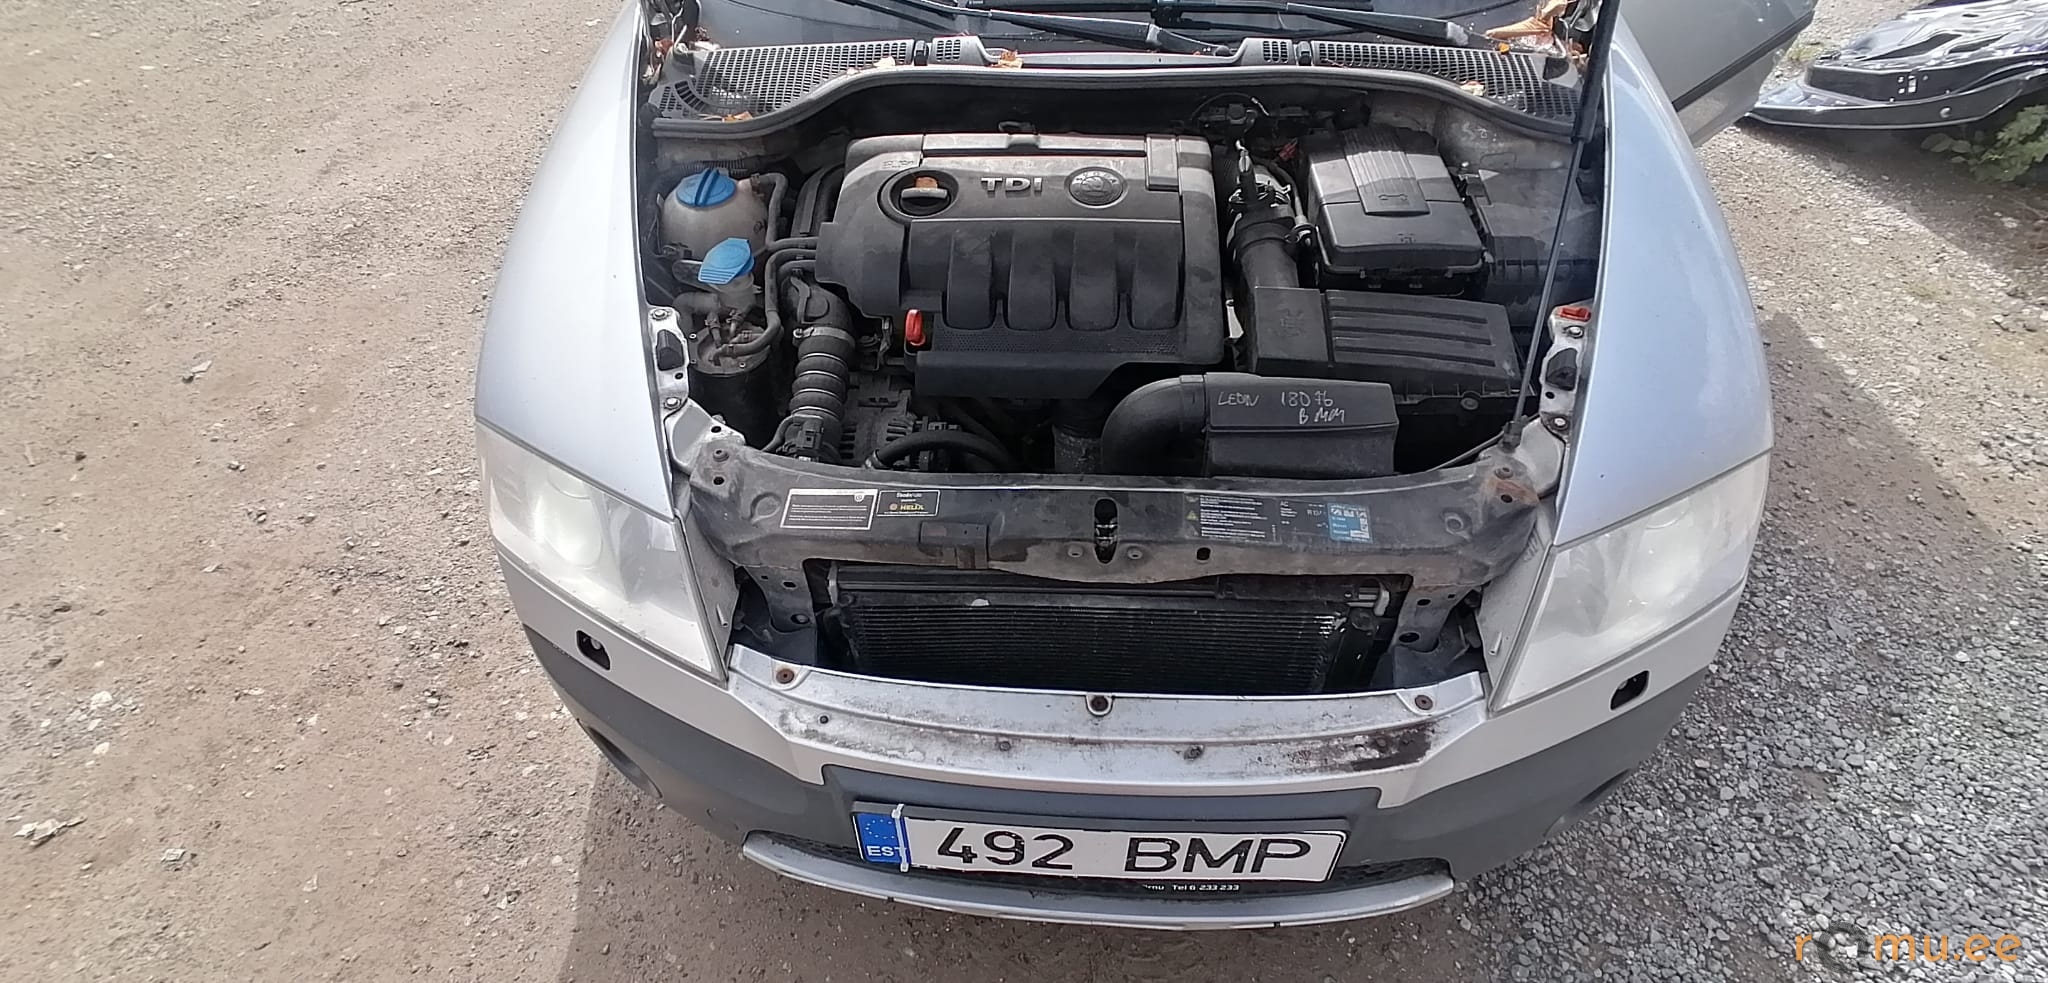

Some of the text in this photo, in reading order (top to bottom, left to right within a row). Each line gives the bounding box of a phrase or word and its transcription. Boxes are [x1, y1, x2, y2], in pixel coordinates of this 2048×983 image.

[980, 177, 1043, 192] TDI
[937, 827, 1311, 874] 492 BMP
